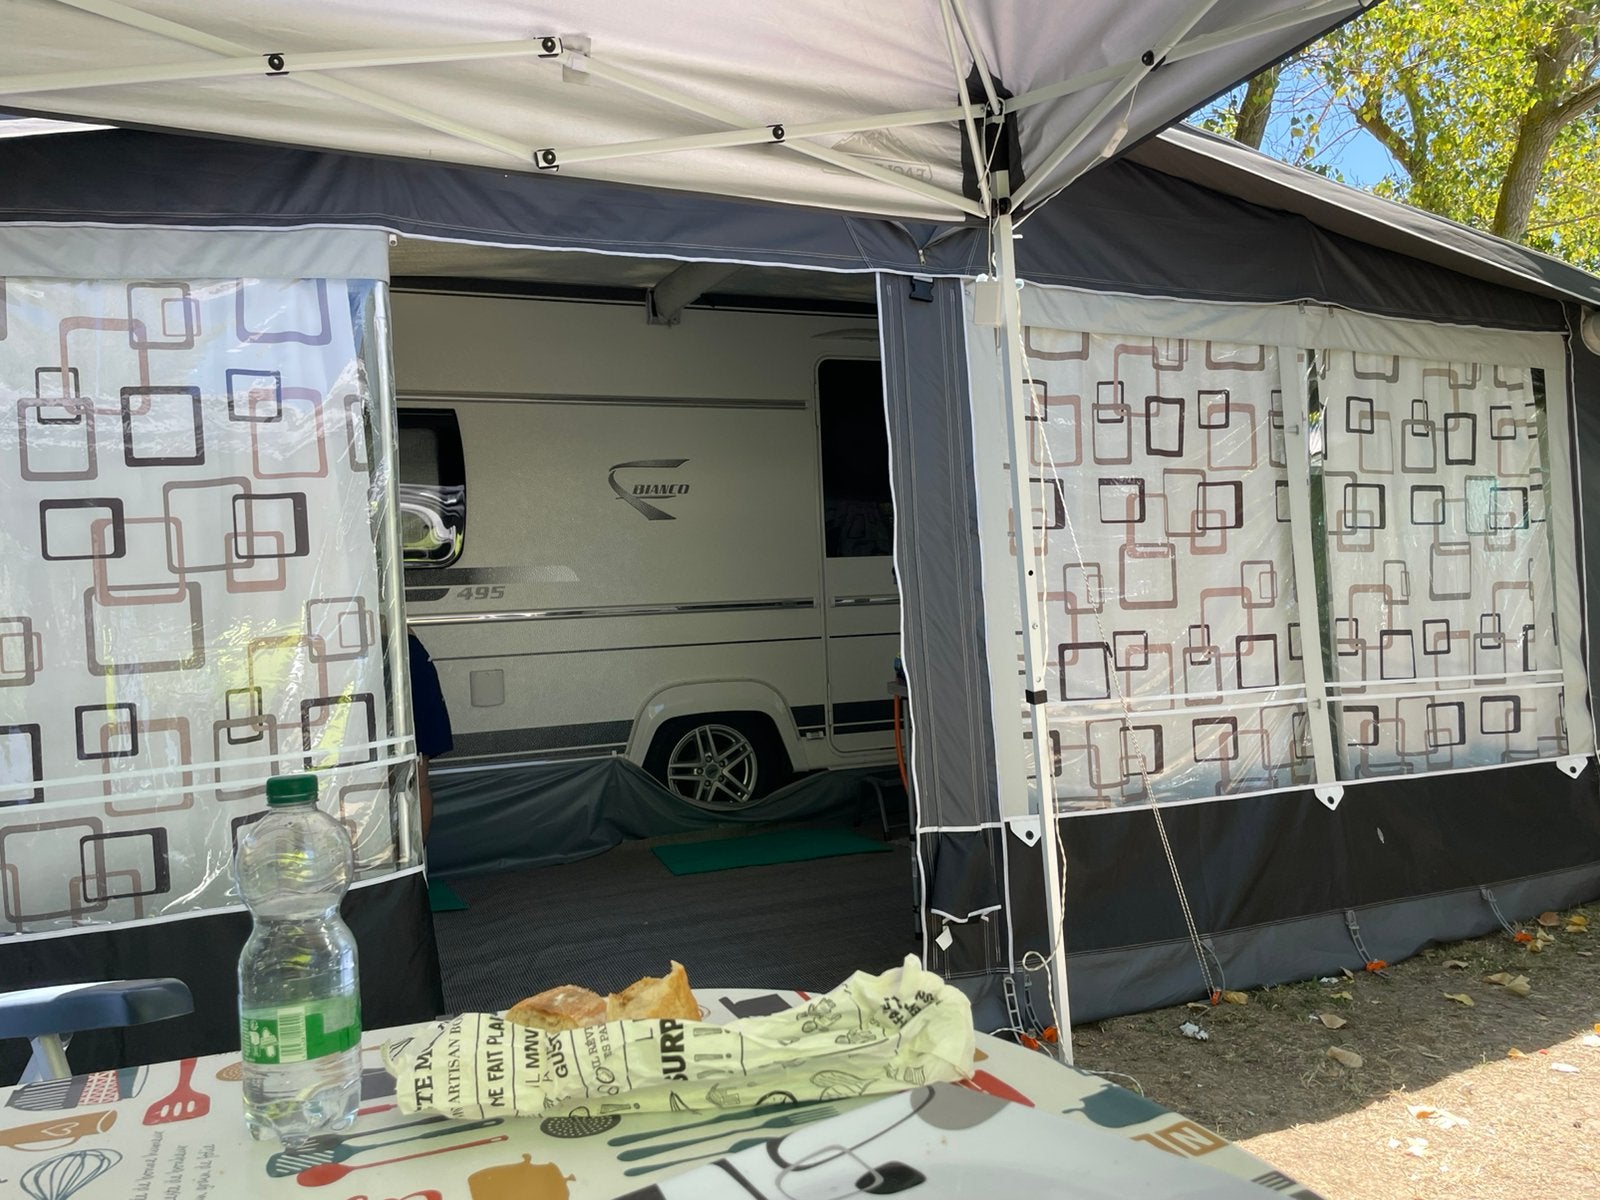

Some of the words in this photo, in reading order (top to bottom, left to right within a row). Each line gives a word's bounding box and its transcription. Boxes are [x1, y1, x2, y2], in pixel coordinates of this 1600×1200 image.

[632, 483, 690, 495] BIANCO
[456, 585, 505, 600] 495
[448, 1039, 460, 1104] ARTISAN
[487, 1050, 505, 1082] FAIT
